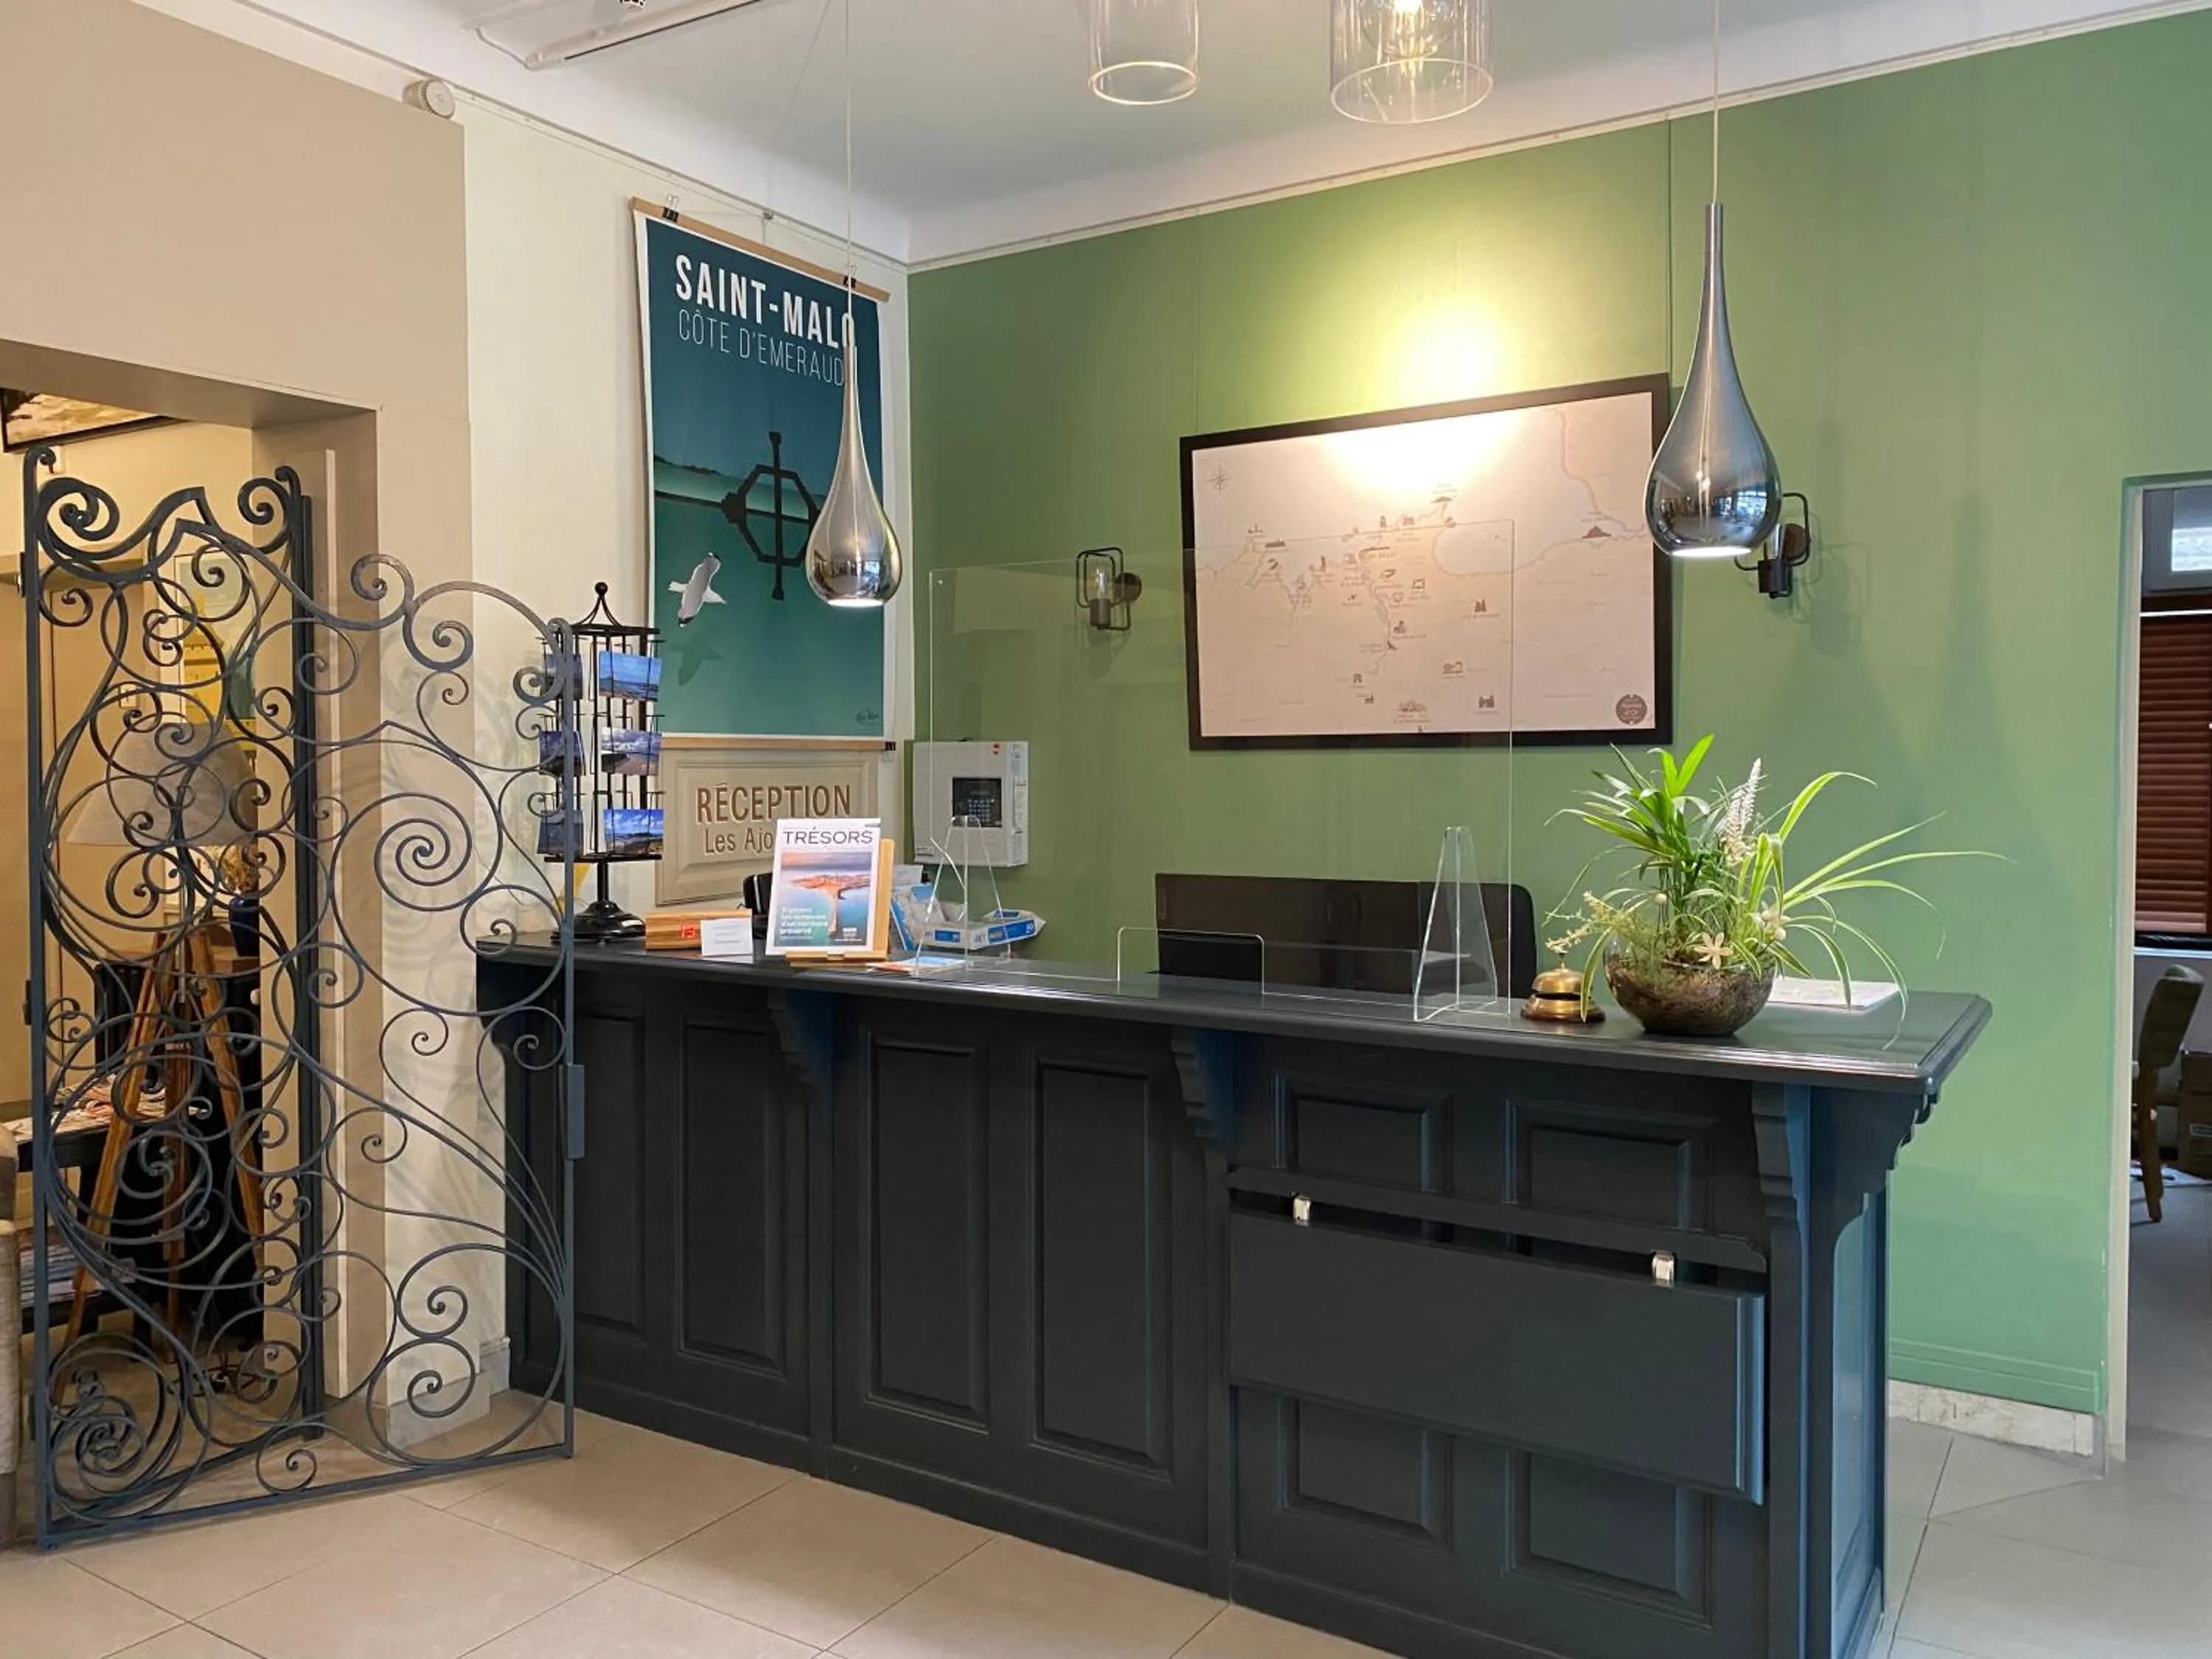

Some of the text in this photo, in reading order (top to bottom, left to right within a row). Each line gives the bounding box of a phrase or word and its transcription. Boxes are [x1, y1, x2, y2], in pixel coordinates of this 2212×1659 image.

[675, 254, 855, 348] SAINT-MALO
[678, 309, 846, 386] CÔTE D'EMERAUD
[697, 783, 850, 823] RÉCEPTION
[705, 827, 774, 853] Les Ajo
[783, 827, 873, 844] TRÉSORS
